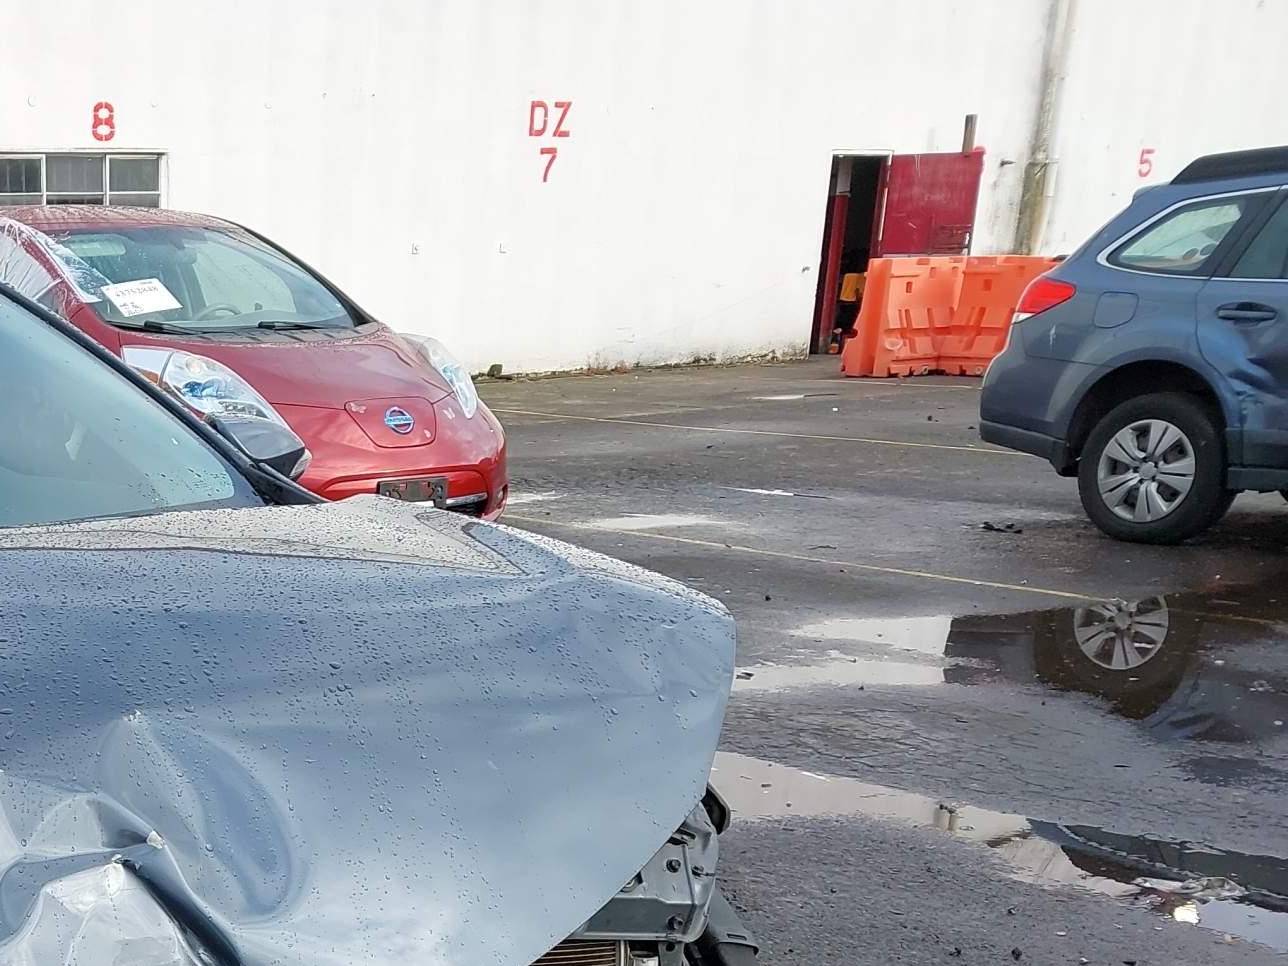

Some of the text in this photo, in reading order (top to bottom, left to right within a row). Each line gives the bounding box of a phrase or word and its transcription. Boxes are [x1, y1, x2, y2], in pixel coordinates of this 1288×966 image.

[92, 102, 116, 142] 8
[529, 101, 571, 137] DZ
[540, 147, 558, 183] 7
[1138, 148, 1155, 178] 5
